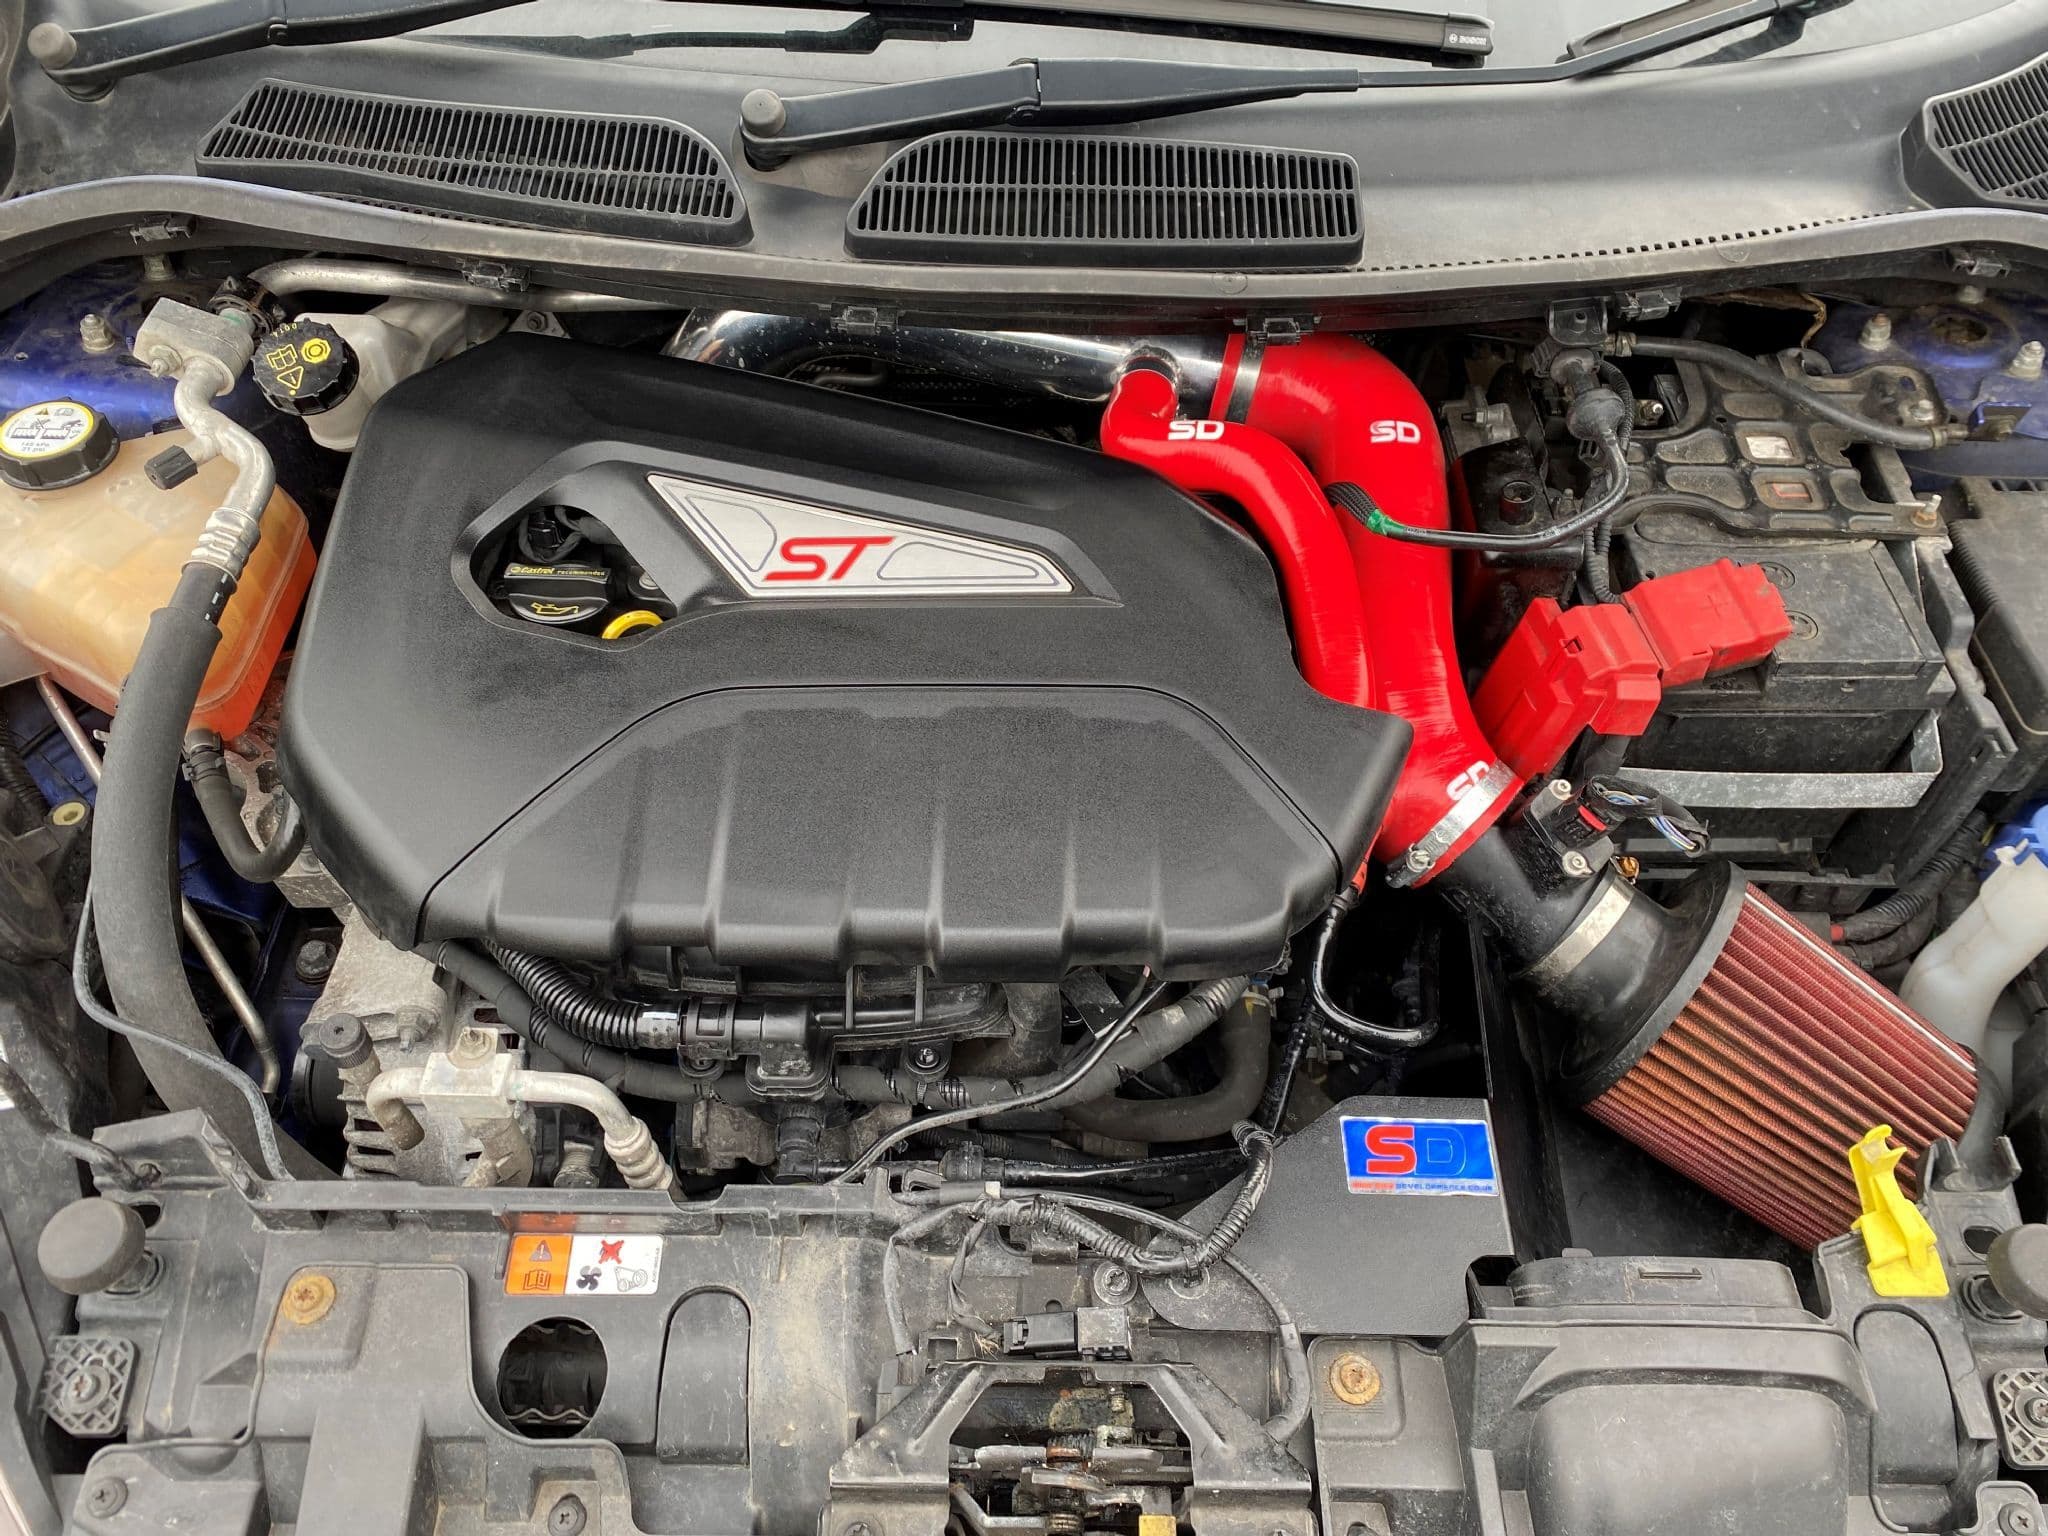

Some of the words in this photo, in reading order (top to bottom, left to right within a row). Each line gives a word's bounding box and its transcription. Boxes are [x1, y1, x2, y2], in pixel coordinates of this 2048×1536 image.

[1168, 419, 1225, 440] SD
[1369, 419, 1421, 444] SD
[762, 536, 896, 580] ST
[520, 566, 555, 576] Castrol
[1365, 1124, 1467, 1176] SD
